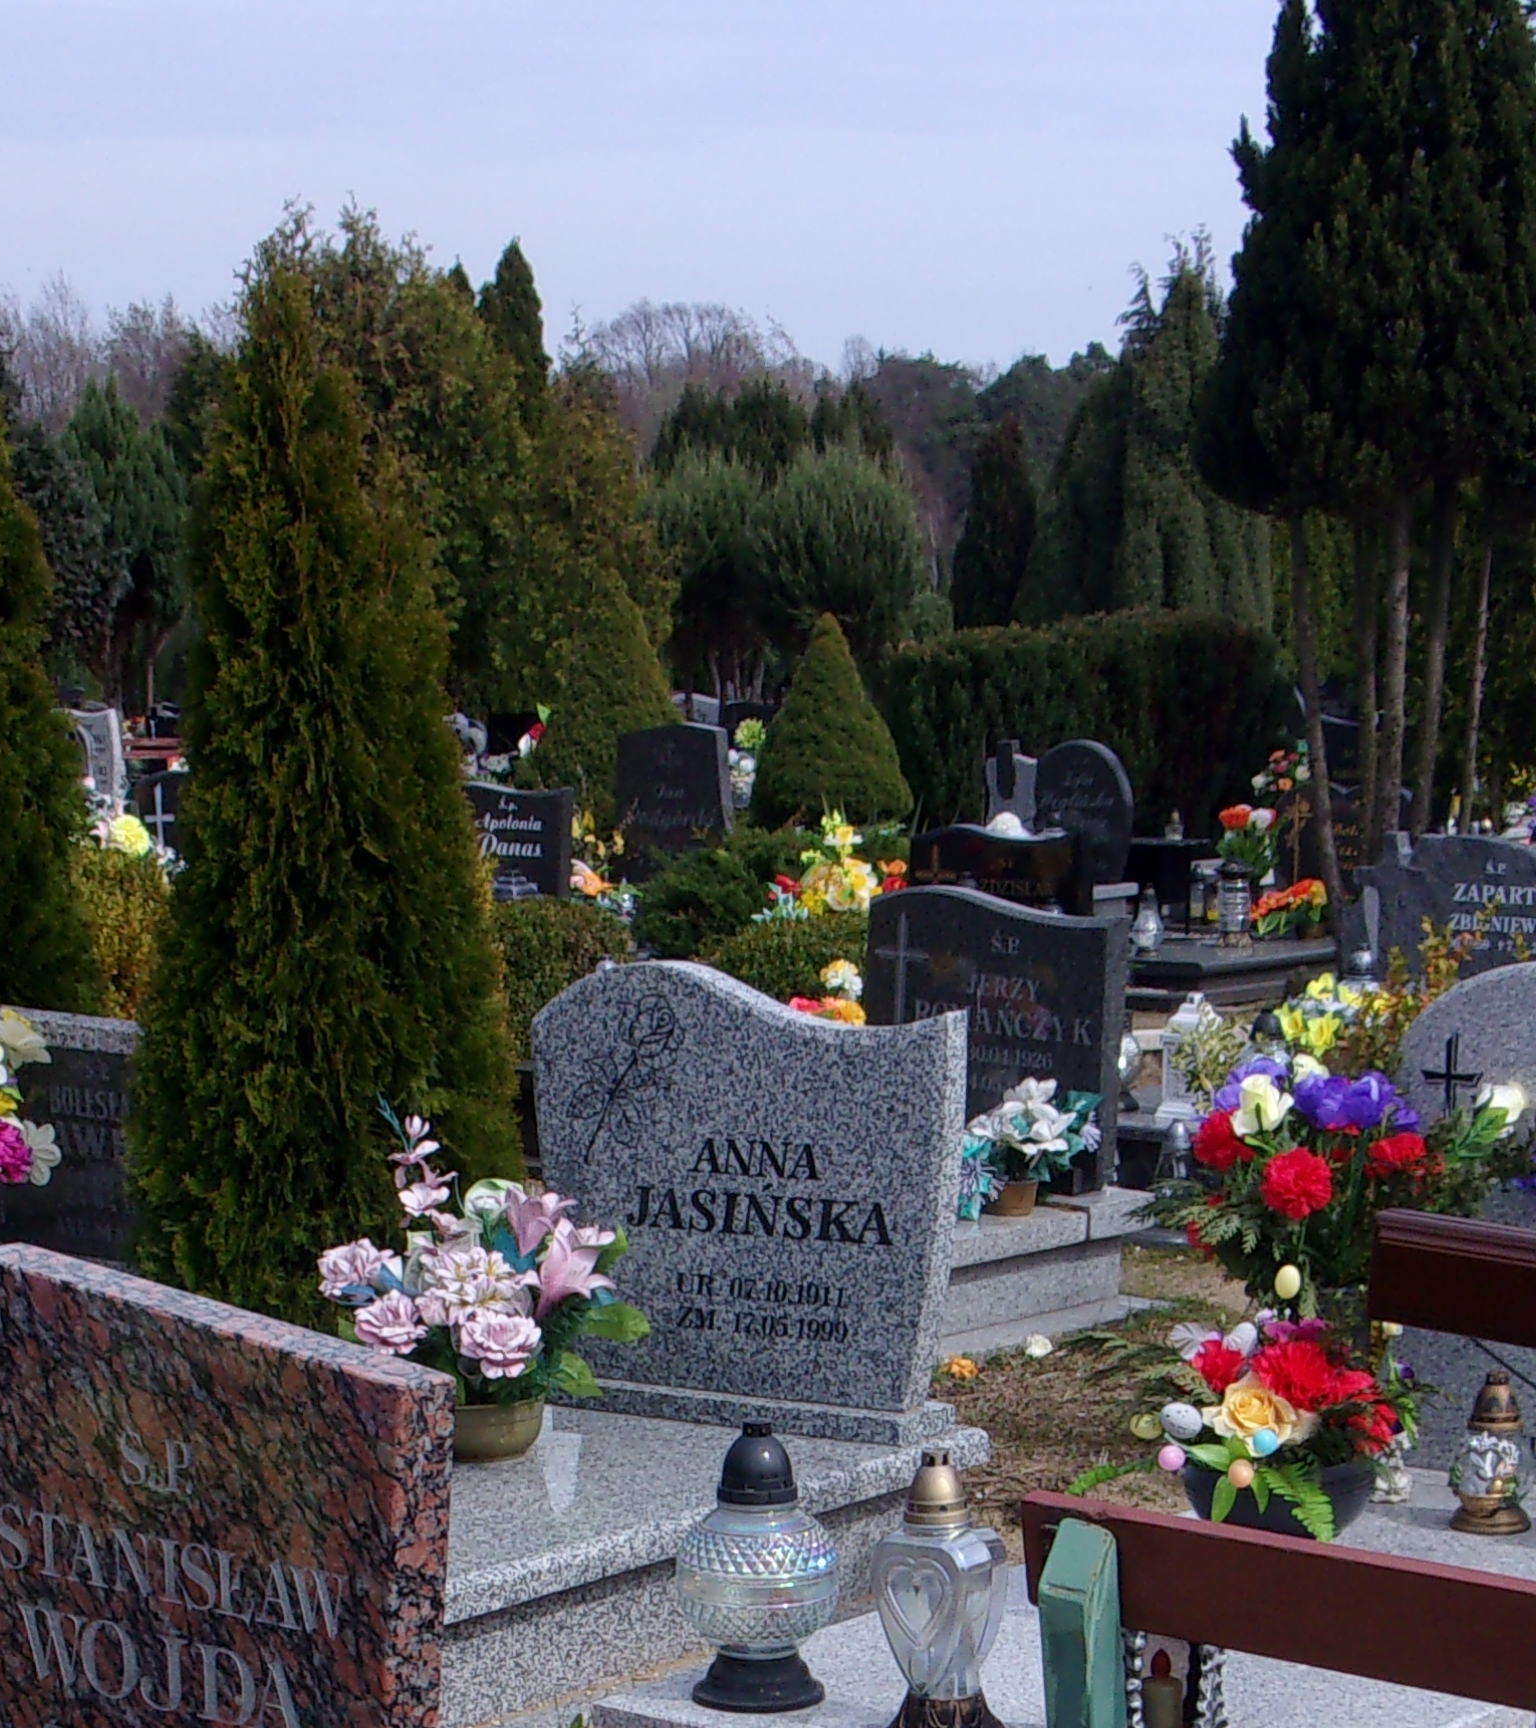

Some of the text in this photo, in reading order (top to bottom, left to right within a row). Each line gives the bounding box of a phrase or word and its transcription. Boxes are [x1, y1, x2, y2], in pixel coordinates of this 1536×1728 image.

[474, 811, 543, 832] Apolonia
[968, 971, 1041, 1002] JERZY
[690, 1137, 821, 1181] ANNA
[626, 1183, 895, 1246] JASIŃSKA
[732, 1311, 850, 1344] 17.05.1999
